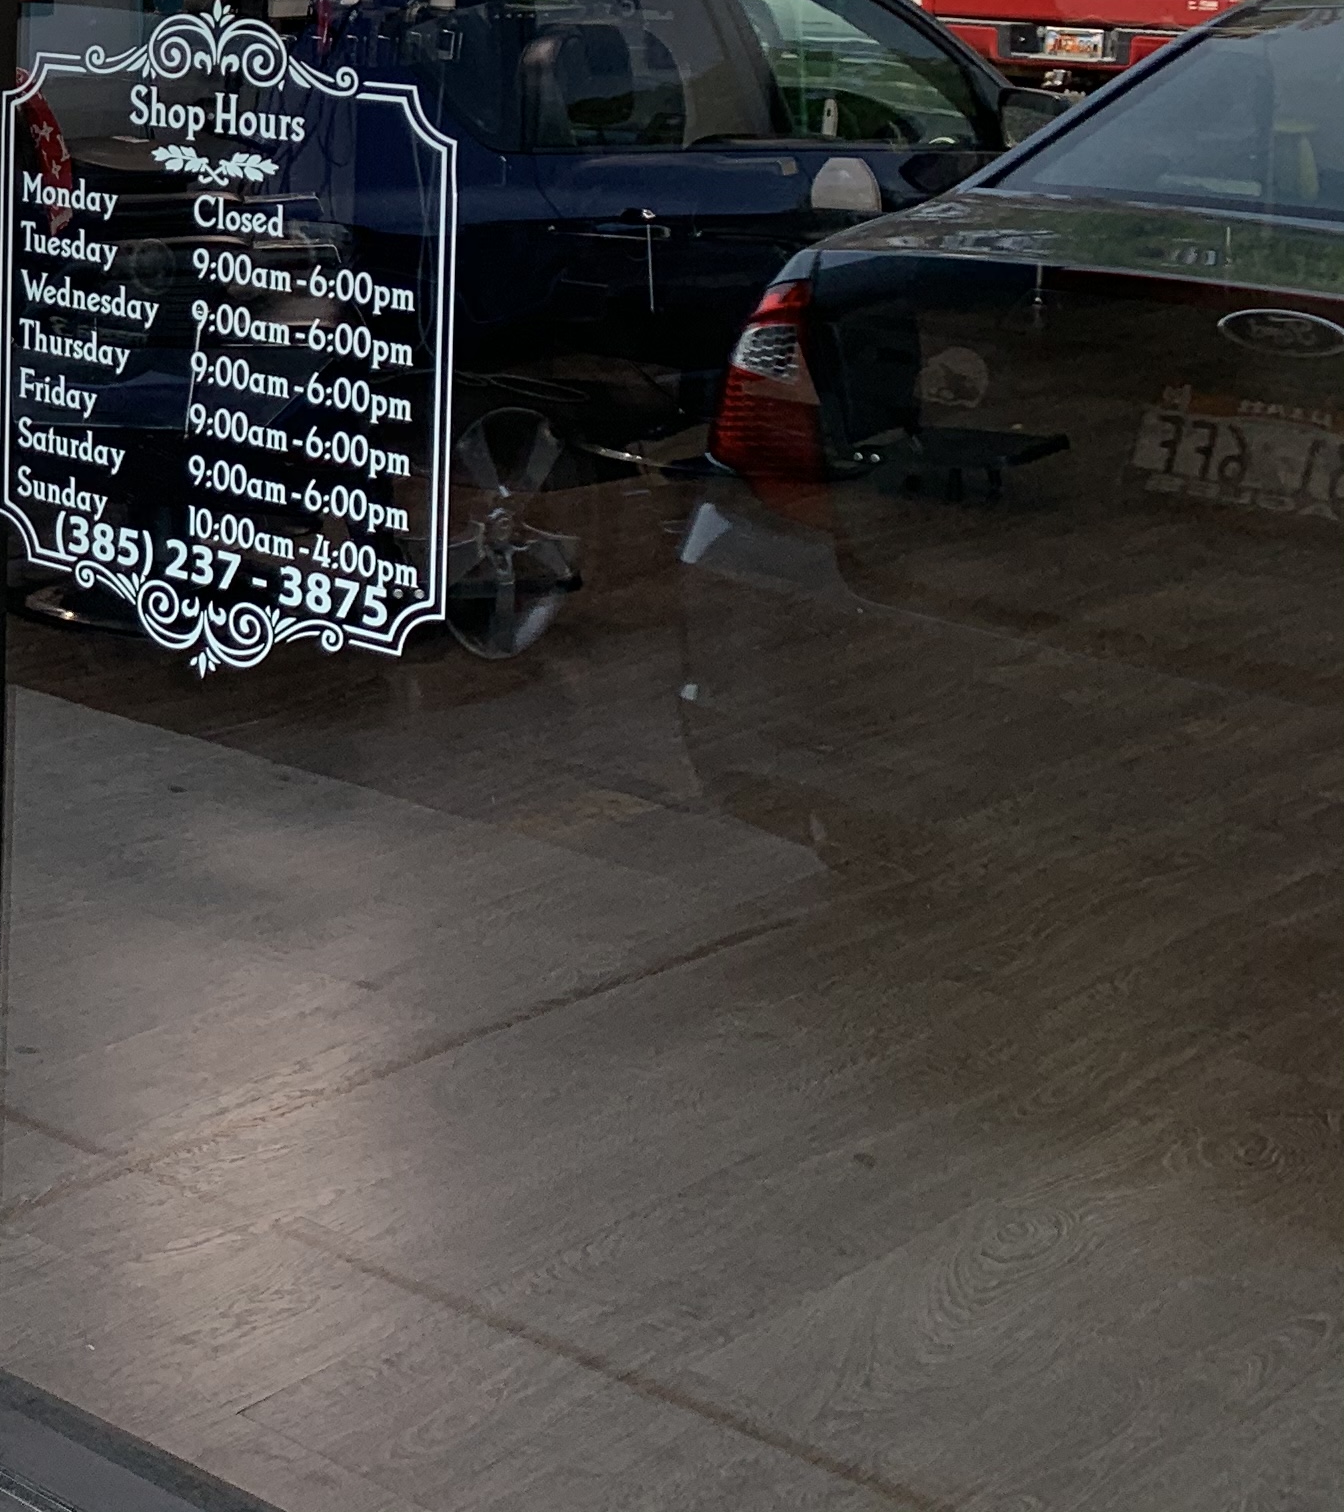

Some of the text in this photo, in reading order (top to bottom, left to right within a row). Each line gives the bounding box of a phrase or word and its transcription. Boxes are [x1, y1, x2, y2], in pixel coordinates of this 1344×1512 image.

[129, 83, 306, 143] Shop Hours
[22, 171, 284, 238] Monday Closed
[20, 220, 119, 272] Tuesday
[20, 268, 160, 330] Wednesday
[19, 317, 131, 374] Thursday
[18, 367, 98, 418] Friday
[17, 415, 126, 475] Saturday
[16, 465, 109, 521] Sunday
[56, 511, 154, 578] (385)
